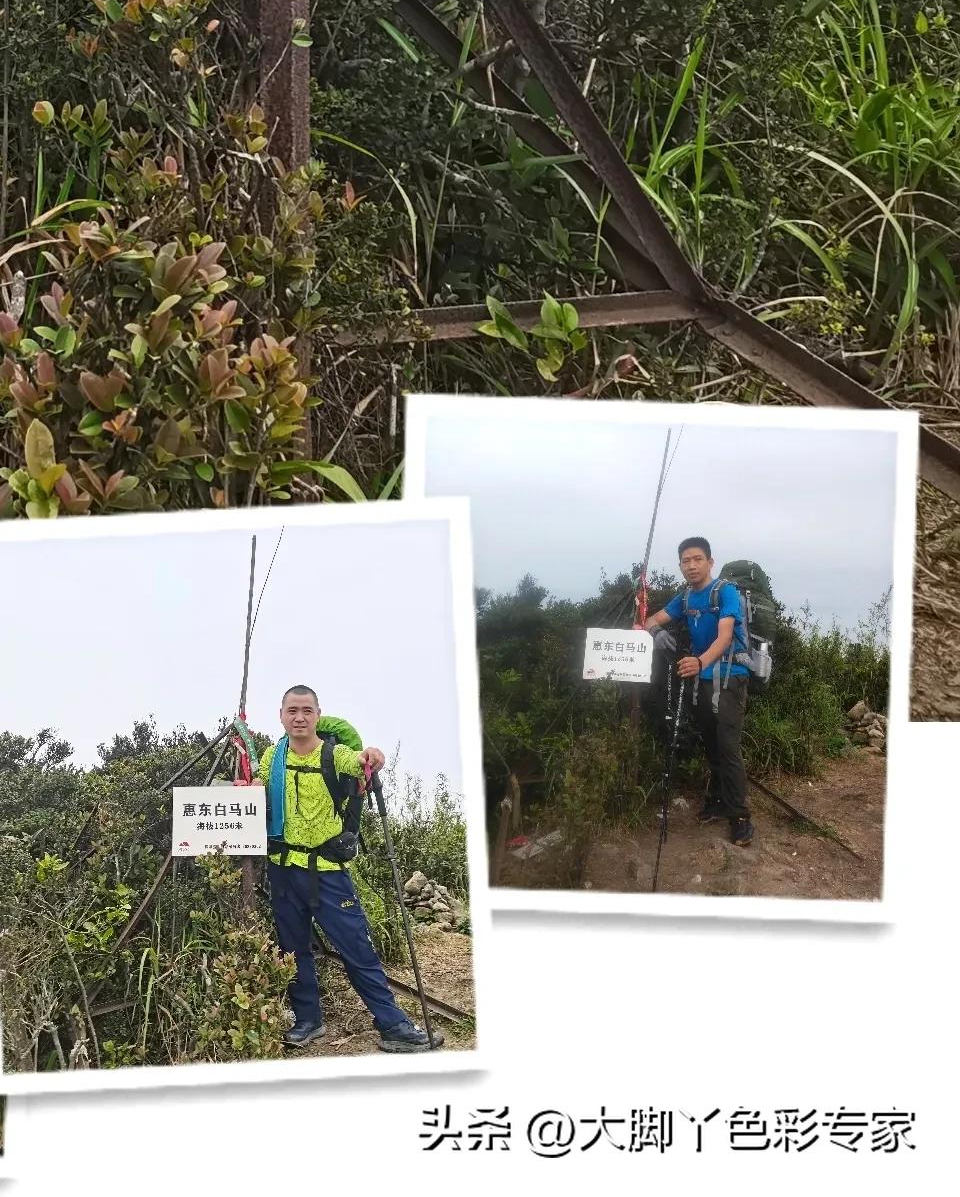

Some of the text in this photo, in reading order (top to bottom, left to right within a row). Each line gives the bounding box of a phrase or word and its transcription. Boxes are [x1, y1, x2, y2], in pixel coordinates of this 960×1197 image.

[182, 802, 257, 817] 惠东白马山
